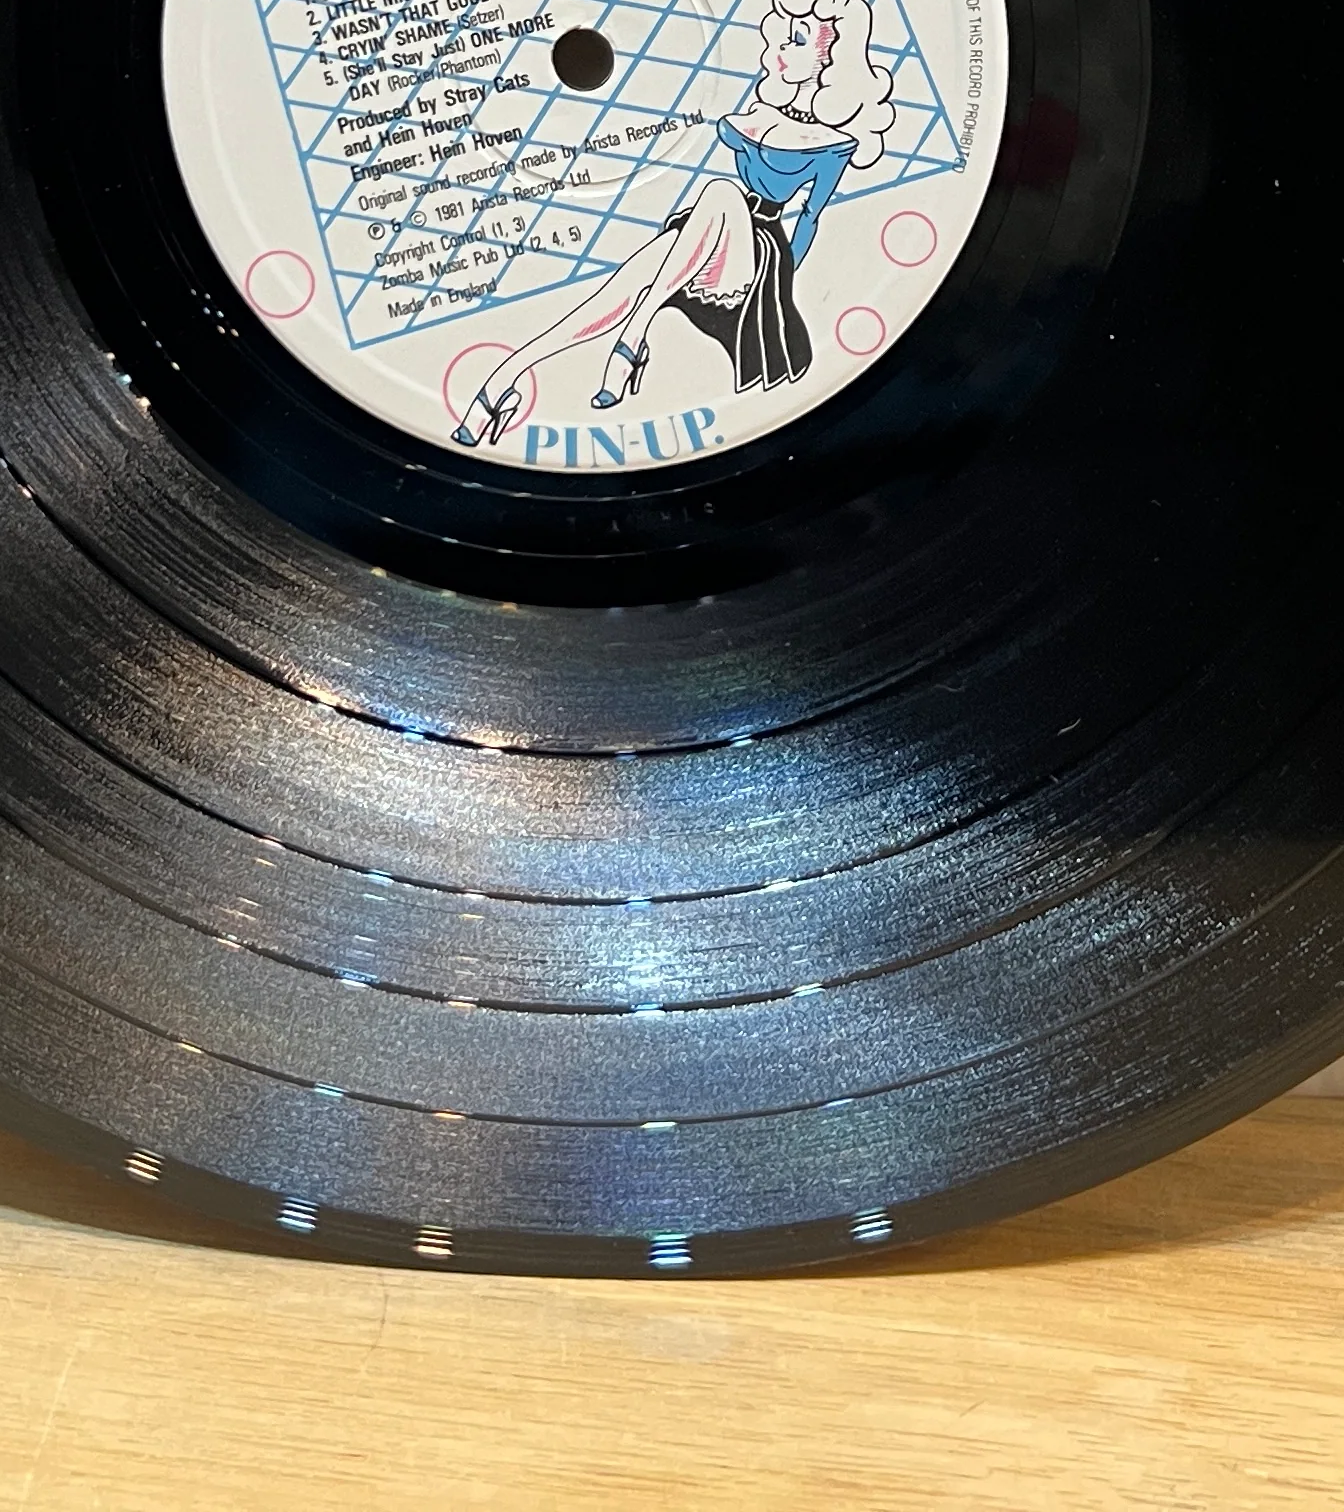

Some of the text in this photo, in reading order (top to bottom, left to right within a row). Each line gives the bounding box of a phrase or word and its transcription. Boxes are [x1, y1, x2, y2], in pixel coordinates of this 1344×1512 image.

[306, 11, 322, 26] 2.
[312, 31, 327, 46] 3.
[331, 13, 392, 41] WASN'T
[398, 0, 439, 23] THAT
[319, 4, 505, 65] 4. CRYIN' SHAME (Setzer)
[969, 17, 983, 46] THIS
[323, 71, 338, 86] 5.
[392, 51, 423, 68] Stay
[431, 35, 465, 59] Just)
[471, 28, 503, 48] ONE
[509, 13, 555, 38] MORE
[968, 49, 983, 98] RECORD
[337, 73, 530, 134] Produced by Stray Cats
[349, 80, 380, 101] DAY
[344, 113, 473, 157] and Hein Hoven
[351, 127, 523, 182] Engineer: Hein Hoven
[358, 109, 704, 211] Original sound recording made by Arista Records Ltd
[435, 201, 465, 222] 1981
[472, 193, 508, 213] Arista
[513, 178, 565, 202] Records
[570, 169, 591, 187] Ltd
[375, 241, 436, 269] Copyright
[440, 226, 486, 251] Control
[512, 215, 525, 232] 3)
[381, 268, 424, 291] Zomba
[429, 256, 469, 278] Music
[473, 248, 499, 267] Pub
[503, 241, 525, 259] Ltd
[568, 225, 582, 243] 5)
[387, 278, 497, 319] Made in England
[523, 407, 724, 468] PIN-UP.
